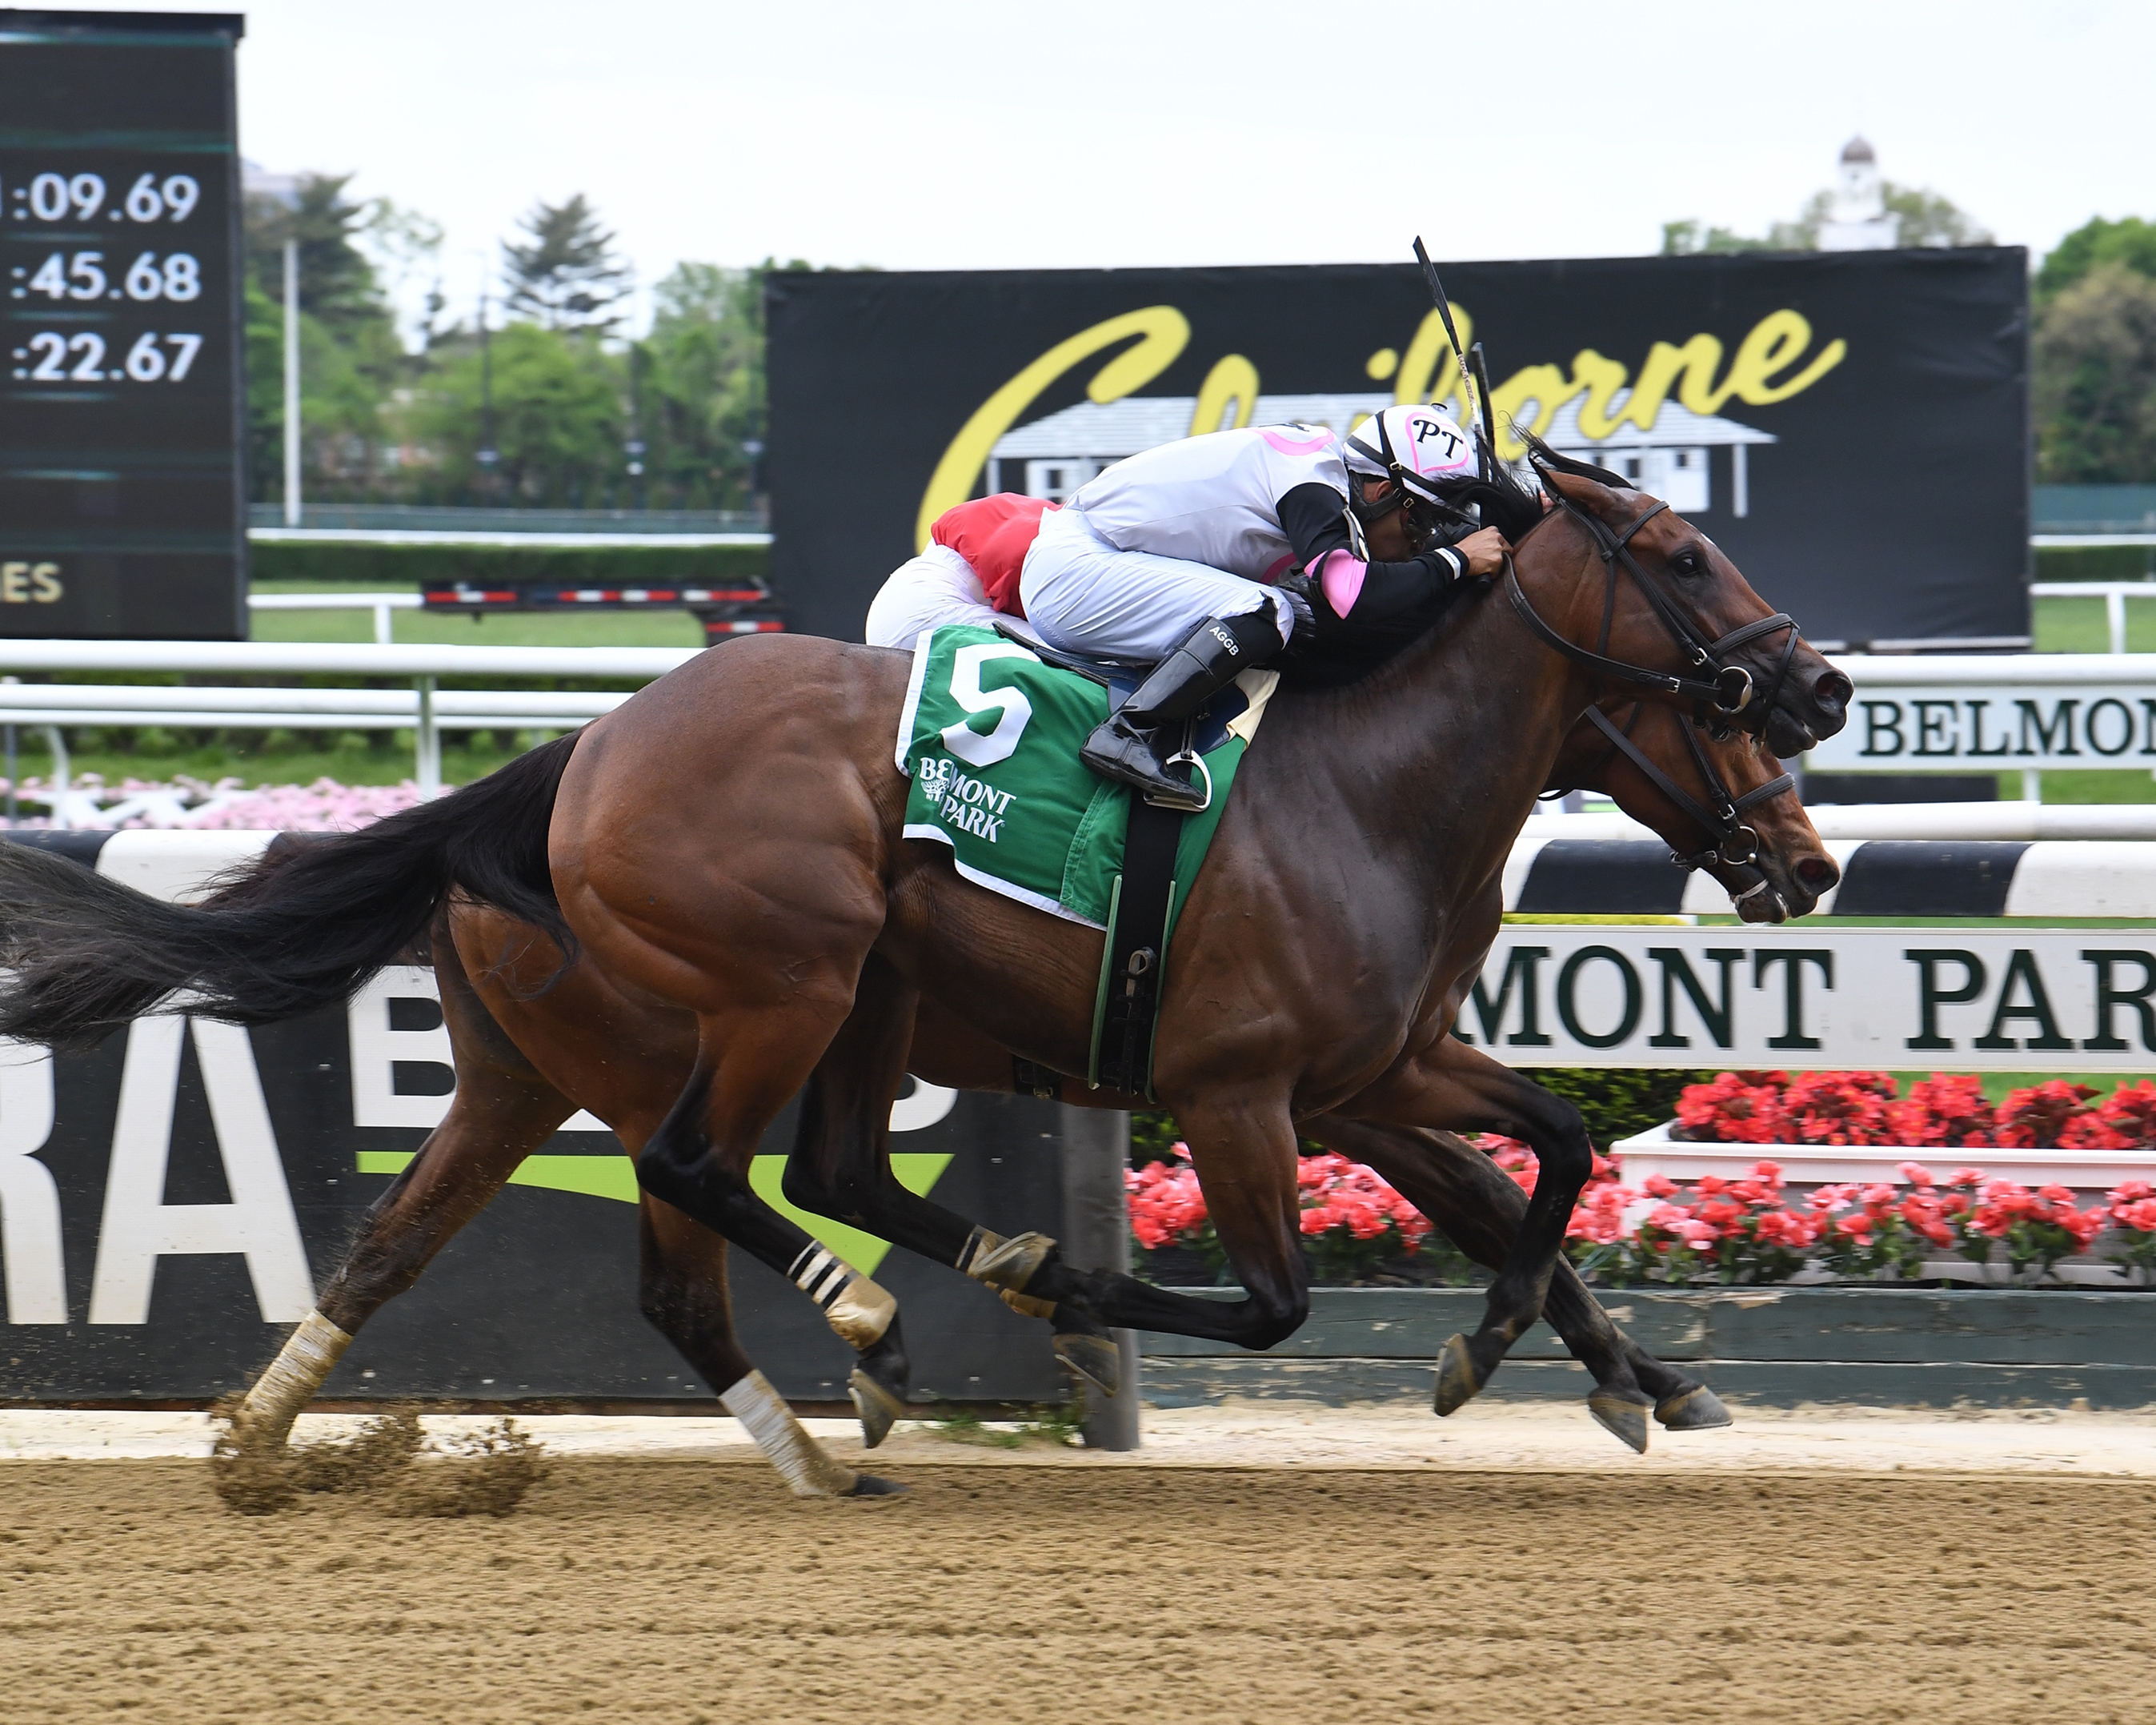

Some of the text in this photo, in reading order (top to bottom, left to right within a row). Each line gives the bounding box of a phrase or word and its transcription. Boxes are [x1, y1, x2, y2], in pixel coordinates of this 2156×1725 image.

[0, 173, 199, 222] :09.69
[10, 252, 201, 301] :45.68
[11, 331, 202, 381] :22.67
[915, 301, 1846, 556] Clborne
[1208, 626, 1240, 656] AGGB
[940, 643, 1041, 768] 5
[940, 794, 1005, 843] PARK
